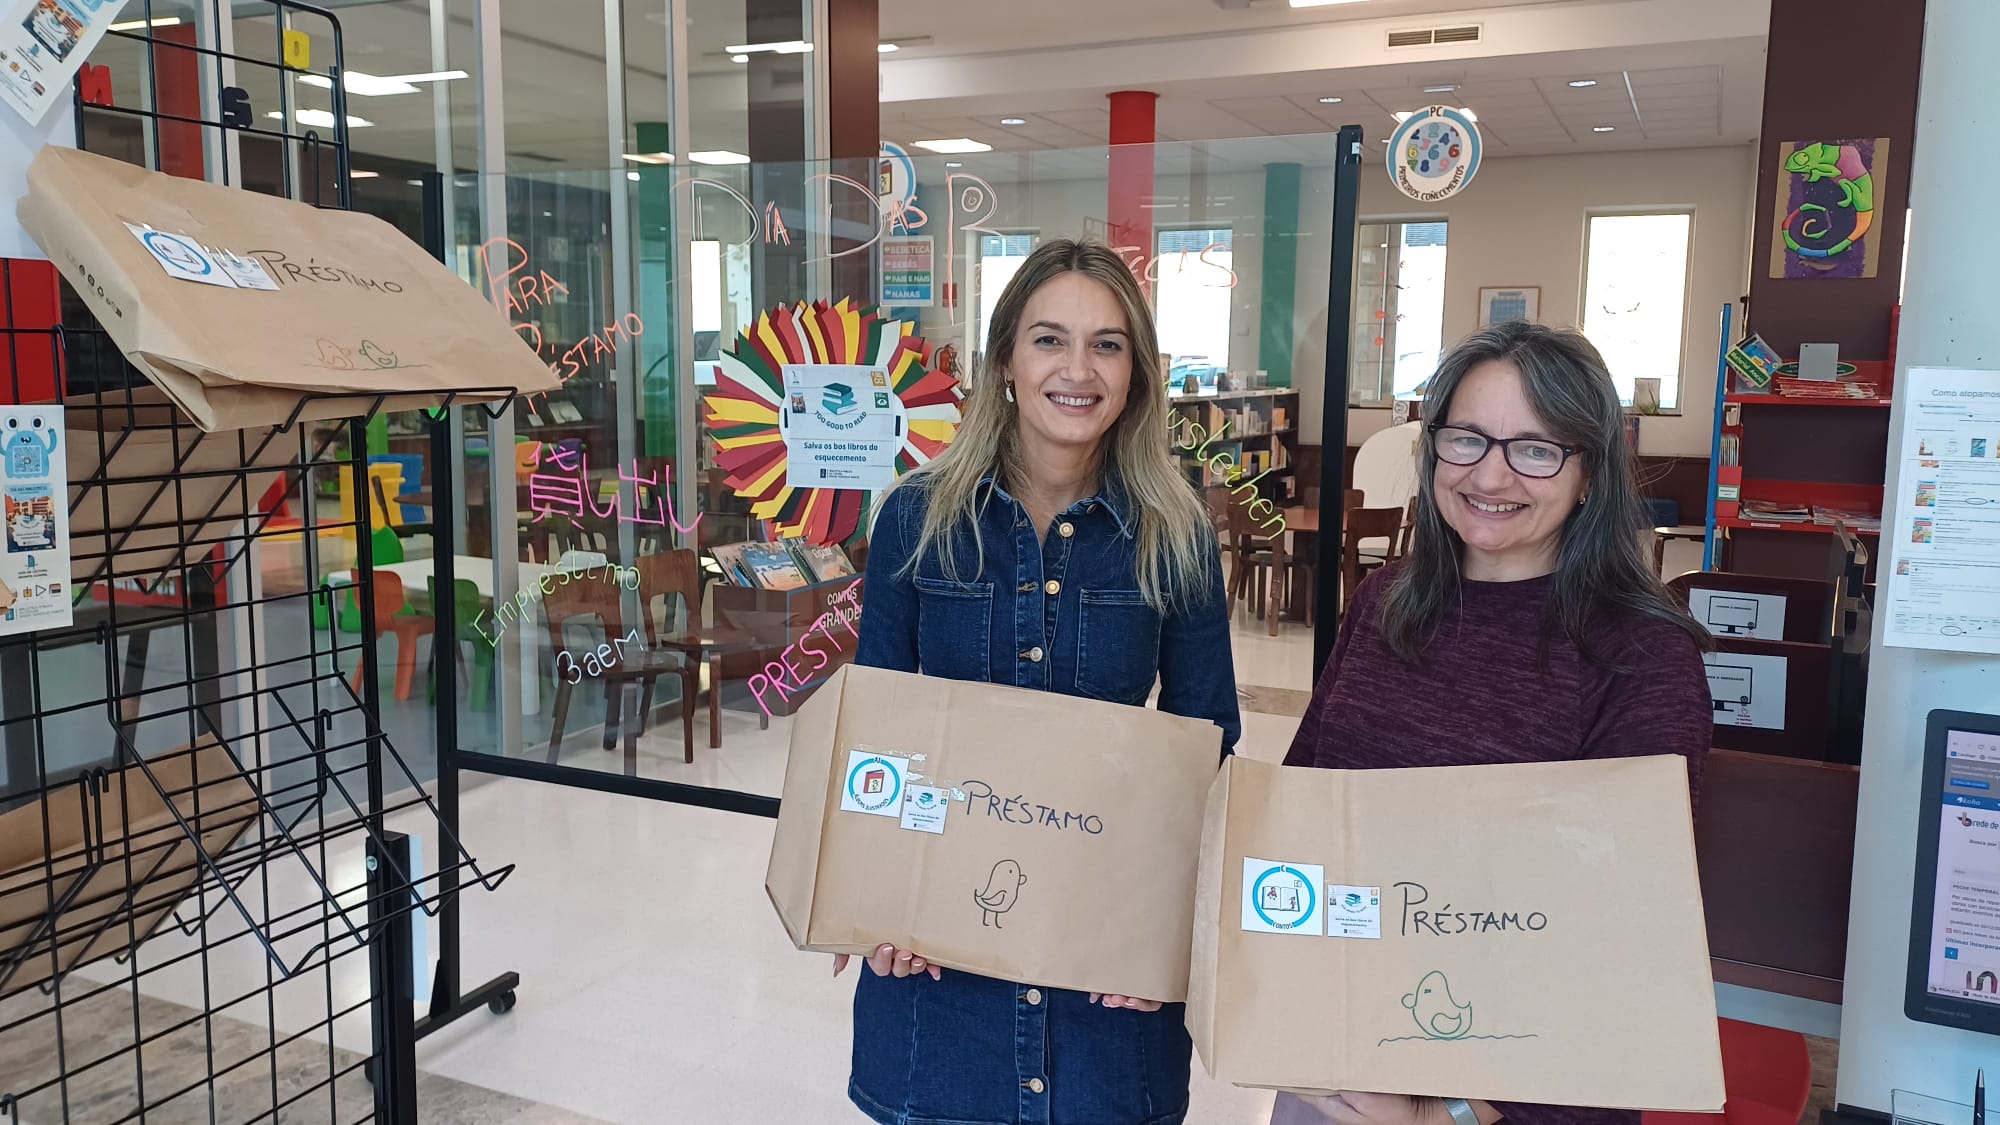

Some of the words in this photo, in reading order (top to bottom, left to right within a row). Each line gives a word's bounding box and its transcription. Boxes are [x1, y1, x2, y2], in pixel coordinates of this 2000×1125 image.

[1430, 106, 1443, 117] PC
[247, 249, 404, 296] PRÉSTAMO
[479, 237, 570, 325] PARA
[512, 313, 644, 415] PÉSTAMO
[1932, 389, 1957, 398] Como
[814, 410, 827, 424] TOO
[826, 420, 844, 431] GOOD
[853, 411, 867, 427] READ
[803, 442, 823, 451] Salva
[833, 442, 846, 451] bos
[847, 442, 867, 451] libros
[868, 443, 879, 451] do
[814, 453, 867, 464] esquecemento
[962, 780, 1103, 834] PRÉSTAMO
[1973, 820, 1989, 829] rede
[1990, 821, 1999, 830] de
[1393, 882, 1547, 936] PRÉSTAMO
[1272, 921, 1294, 931] CONTOS
